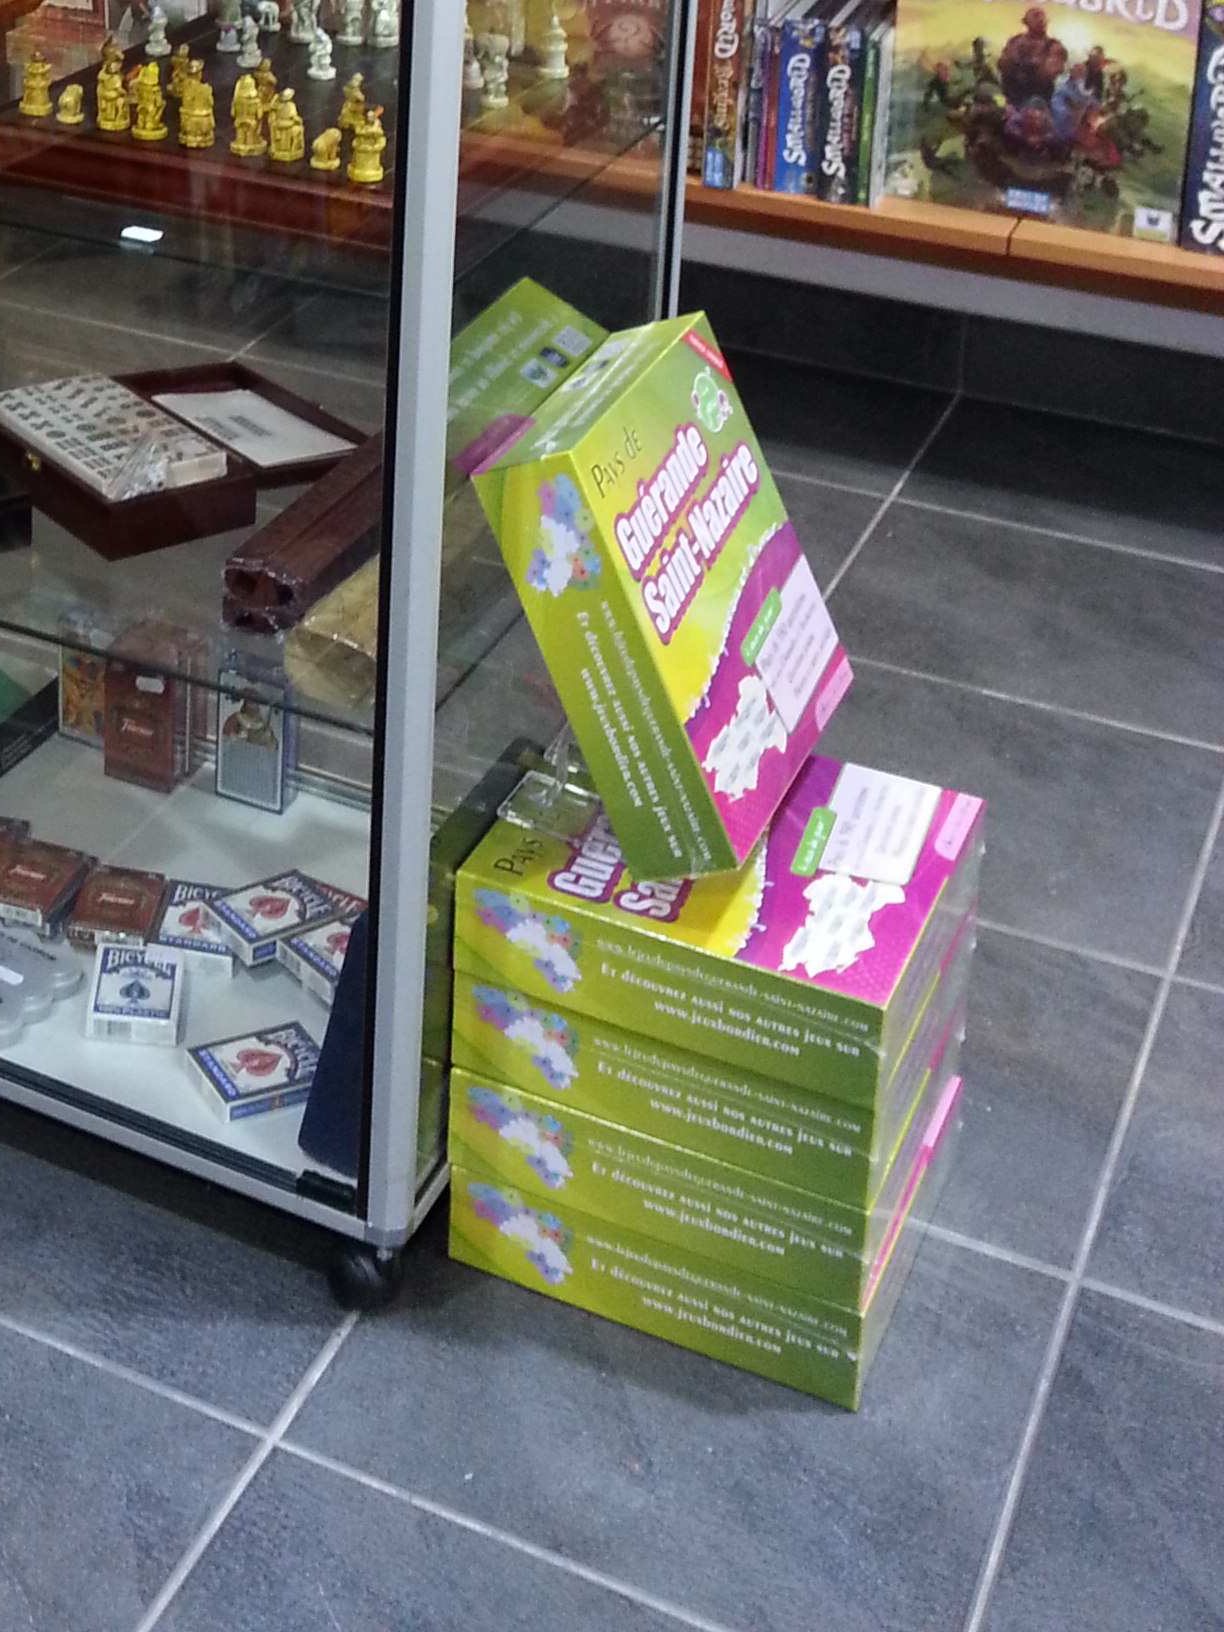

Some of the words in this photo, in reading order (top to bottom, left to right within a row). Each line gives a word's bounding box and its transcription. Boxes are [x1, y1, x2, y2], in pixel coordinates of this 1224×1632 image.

[616, 423, 708, 574] Guérande
[643, 444, 757, 636] Saint-Nazaire
[173, 883, 219, 905] BICY
[271, 876, 329, 922] BICYCLE
[214, 899, 258, 940] STANDARD
[291, 936, 339, 978] STANDARD
[197, 1049, 239, 1098] STANDARD
[274, 1029, 316, 1081] BICYCLE
